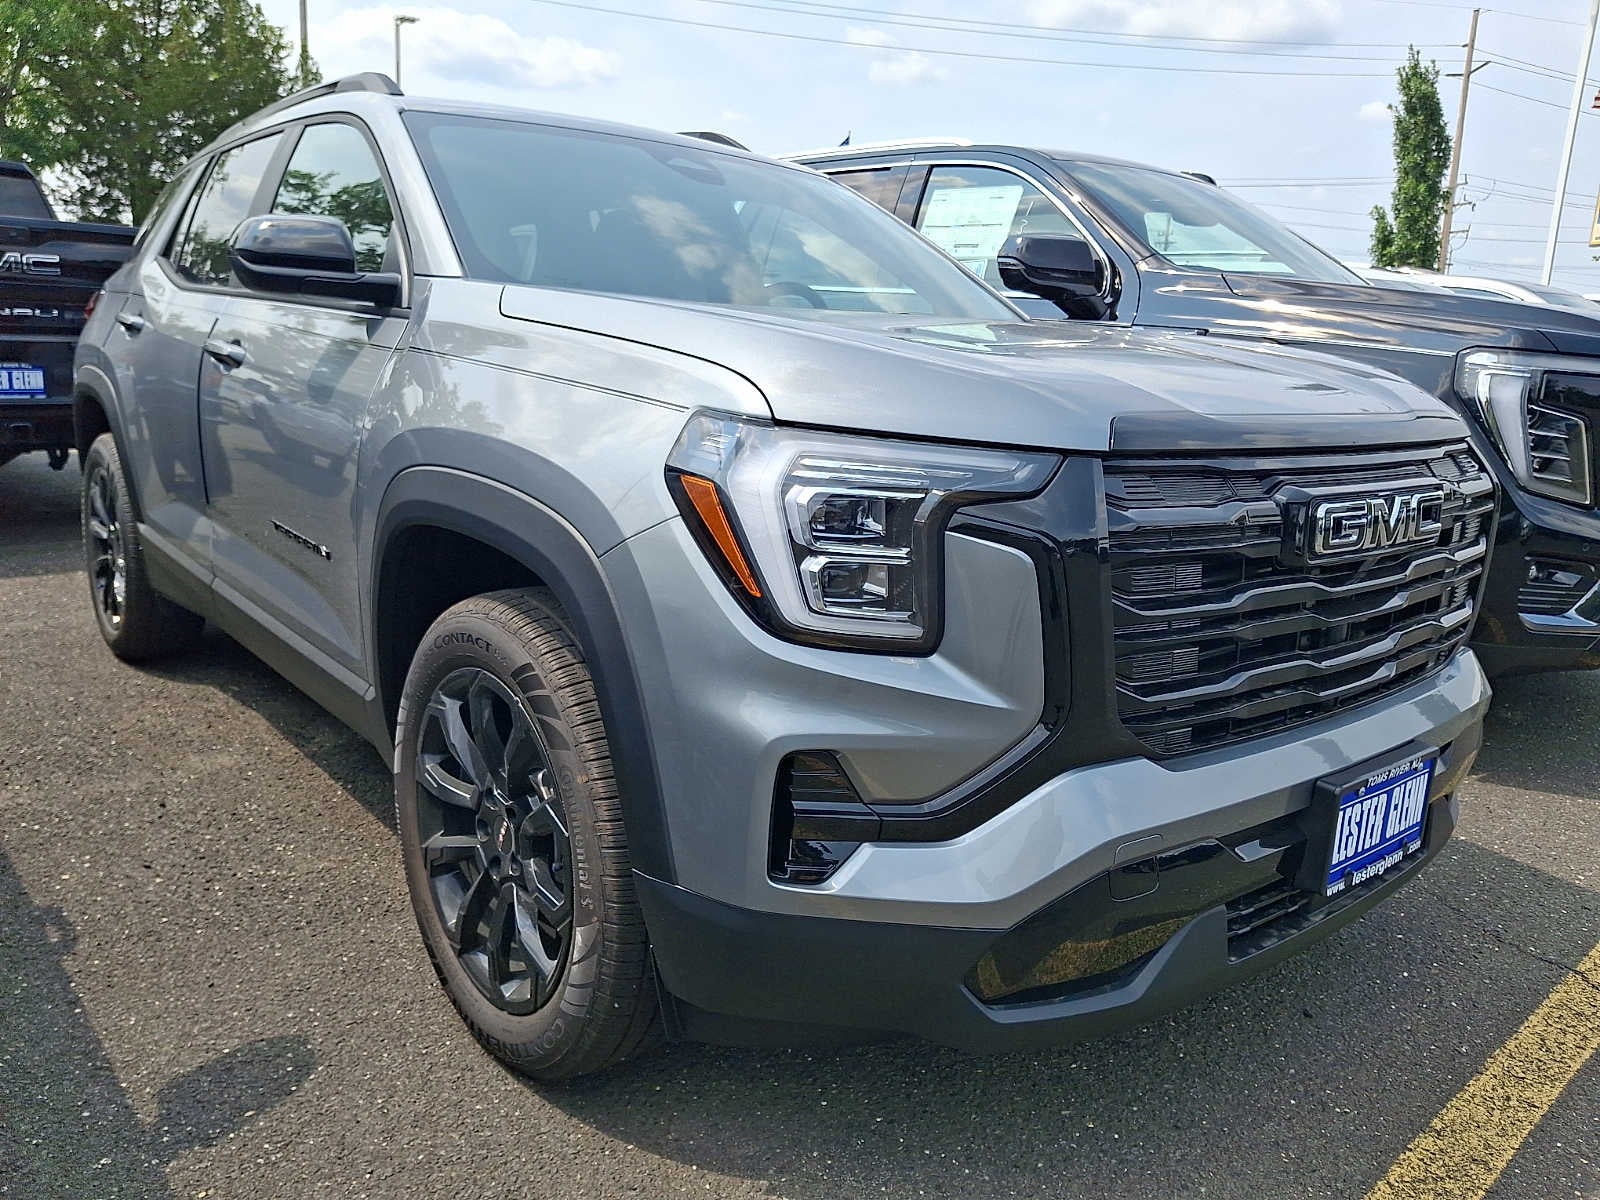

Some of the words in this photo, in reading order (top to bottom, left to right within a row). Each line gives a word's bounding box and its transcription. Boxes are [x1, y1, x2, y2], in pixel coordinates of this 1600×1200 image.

[0, 252, 61, 275] MC
[1315, 491, 1444, 554] GMC
[434, 632, 492, 653] CONTACT
[1367, 772, 1388, 788] TOMS
[1389, 763, 1411, 779] RIVER
[1332, 794, 1386, 864] LESTER
[1386, 773, 1429, 838] GLENN
